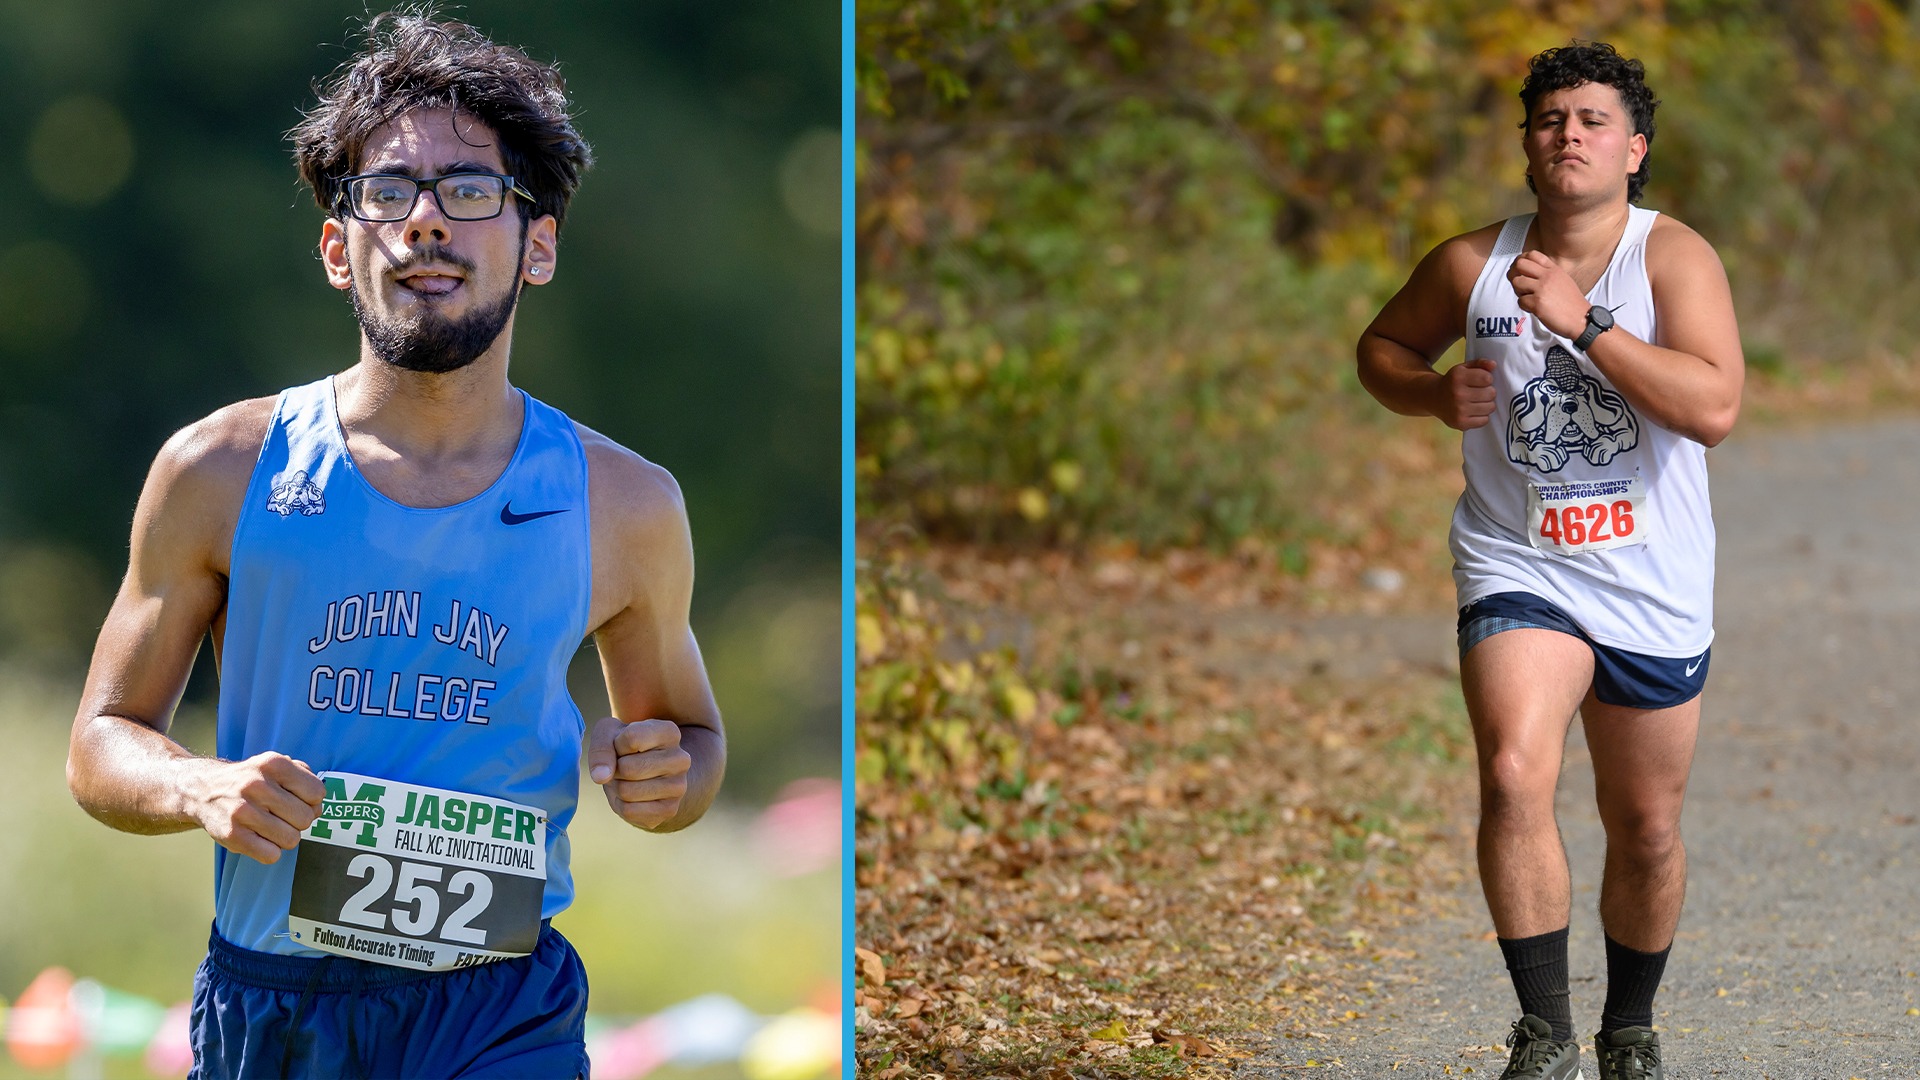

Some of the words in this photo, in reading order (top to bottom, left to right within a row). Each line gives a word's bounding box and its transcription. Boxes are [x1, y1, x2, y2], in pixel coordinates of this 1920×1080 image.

[1475, 316, 1527, 335] CUNY
[1540, 486, 1629, 501] CHAMPIONSHIPS
[1594, 480, 1633, 489] COUNTRY
[1540, 500, 1635, 546] 4626
[308, 590, 421, 654] JOHN
[433, 599, 510, 667] JAY
[308, 665, 497, 725] COLLEGE
[396, 791, 536, 846] JASPER
[394, 829, 423, 853] FALL
[425, 834, 445, 856] XC
[445, 837, 535, 870] INVITATIONAL
[338, 854, 494, 946] 252
[313, 927, 347, 949] Fulton
[346, 934, 397, 958] Accurate
[398, 942, 436, 967] Timing
